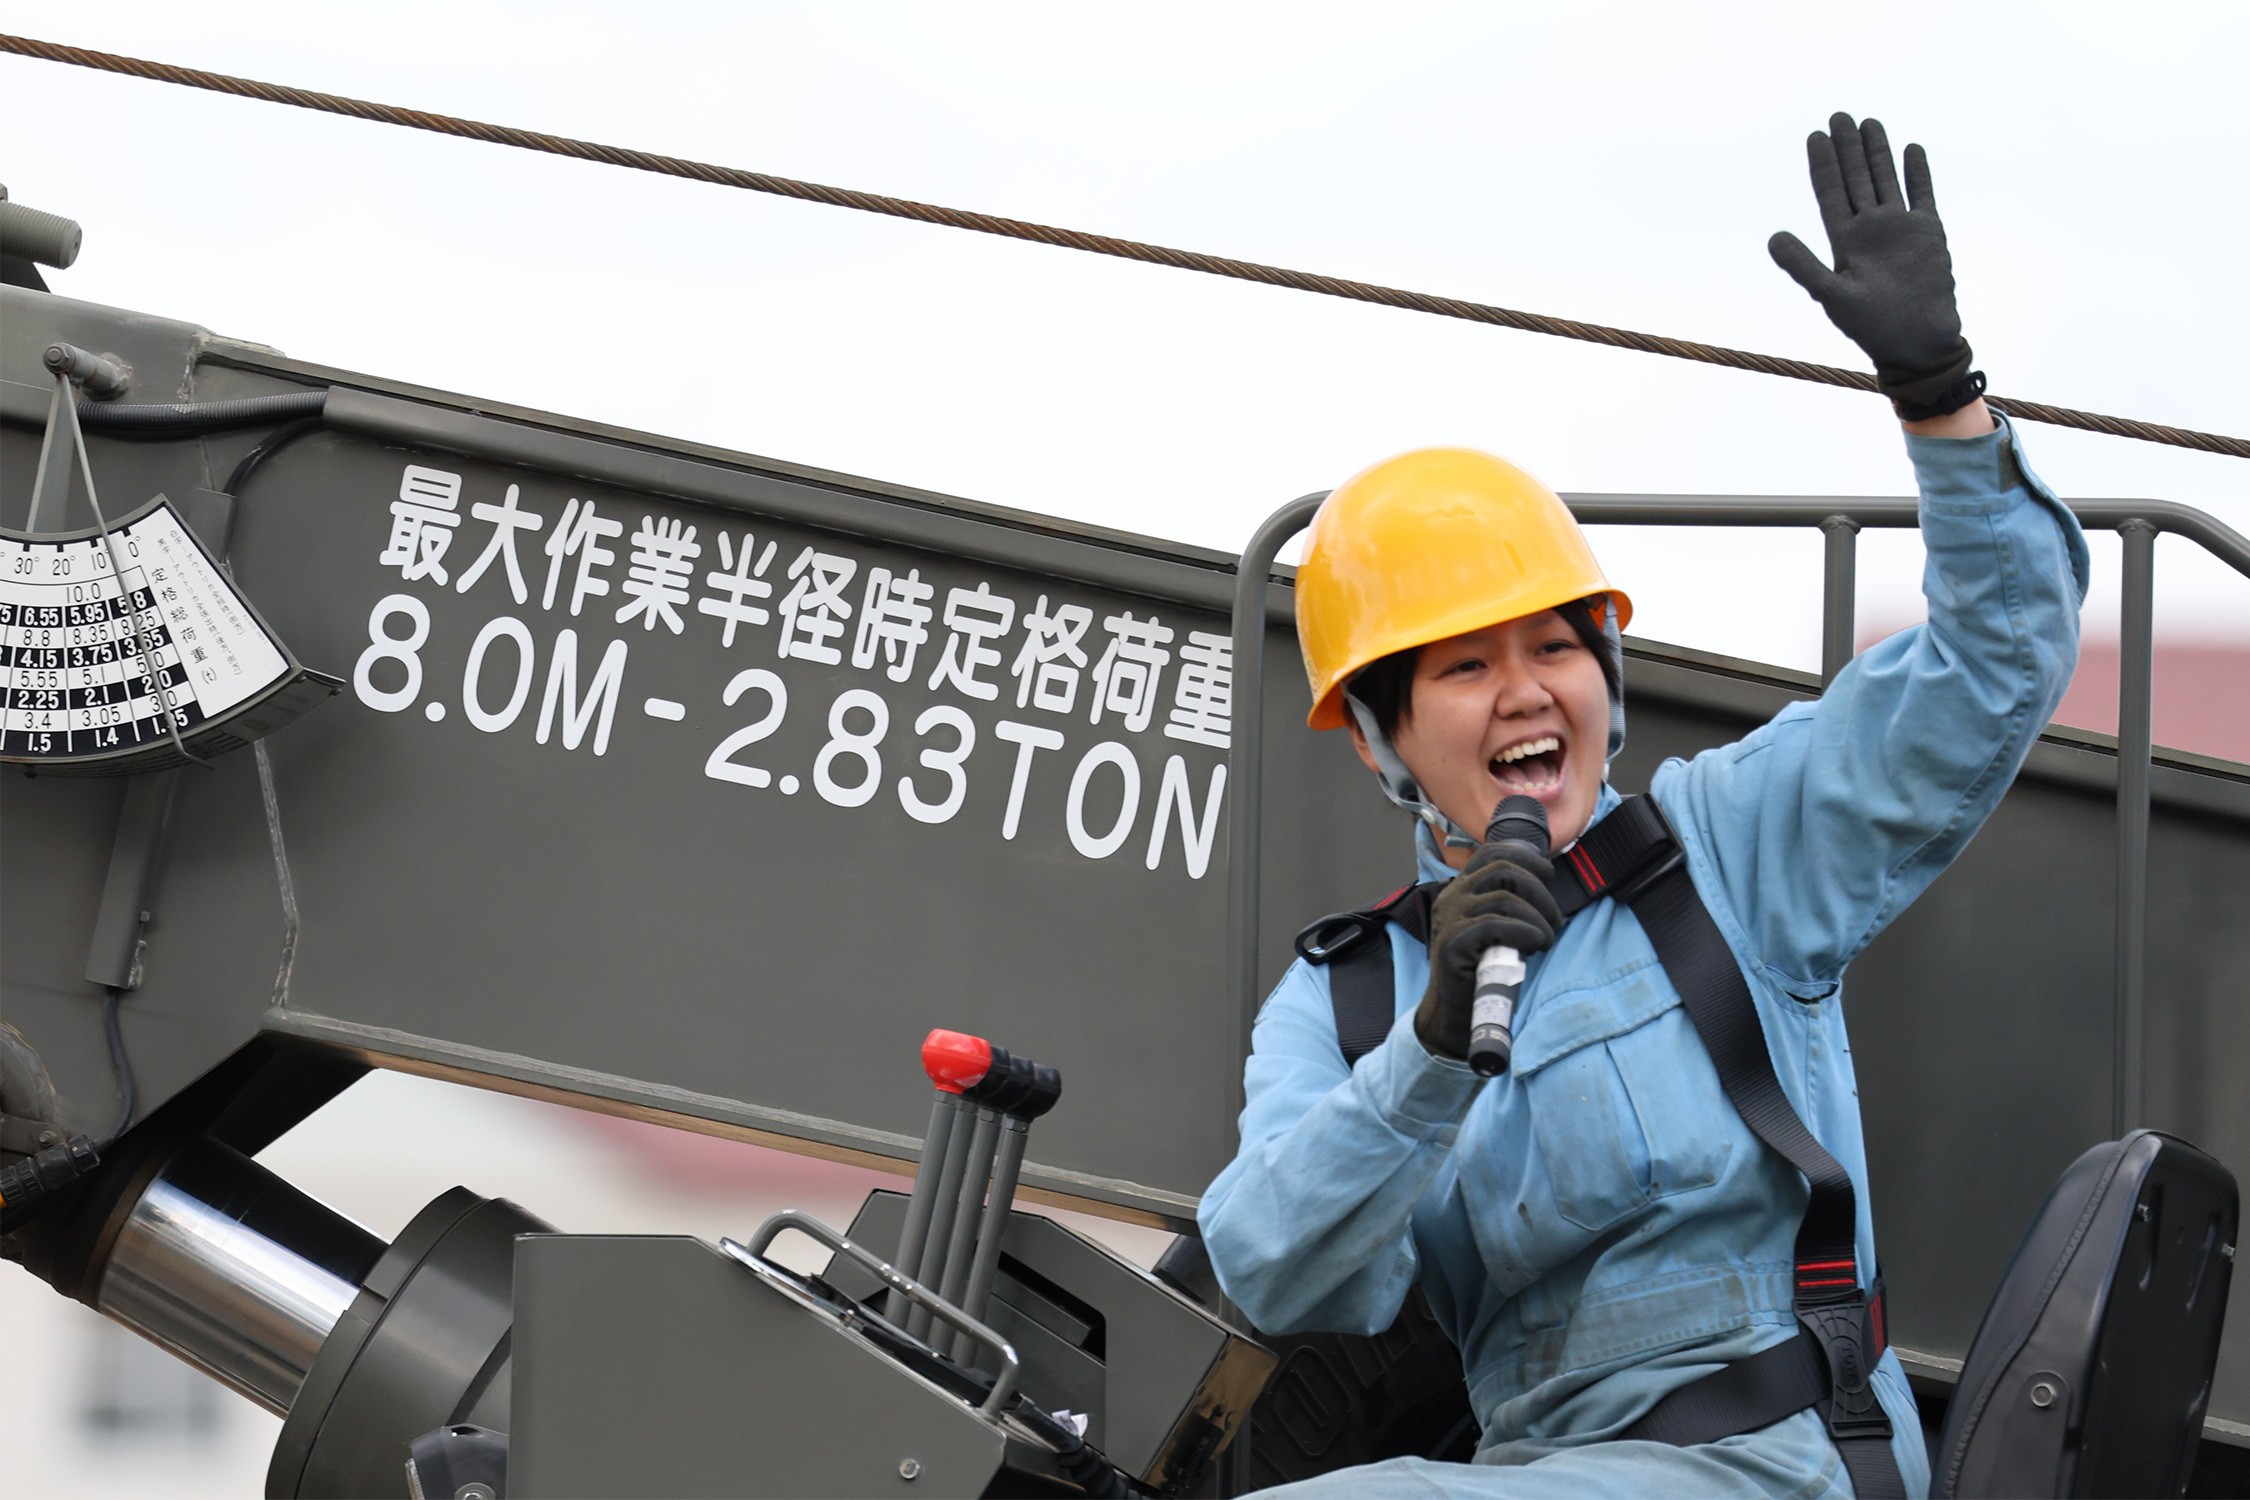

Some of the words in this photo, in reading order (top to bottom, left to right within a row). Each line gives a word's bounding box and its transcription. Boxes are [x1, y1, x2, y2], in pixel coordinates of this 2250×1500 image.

[14, 556, 40, 575] 30°
[52, 555, 76, 576] 20°
[67, 582, 101, 604] 10.0
[379, 464, 1232, 749] 最大作業半径時定格荷重
[24, 607, 59, 626] 6.55
[70, 603, 105, 625] 5.95
[24, 629, 50, 647] 8.8
[73, 624, 108, 644] 8.35
[20, 649, 58, 668] 4.15
[72, 643, 113, 666] 3.75
[20, 670, 58, 688] 5.55
[83, 666, 106, 685] 5.1
[136, 651, 165, 673] 50
[17, 690, 59, 709] 2.25
[84, 686, 110, 706] 2.1
[141, 669, 173, 694] 20
[24, 711, 51, 729] 3.4
[82, 705, 121, 727] 3.05
[150, 690, 177, 712] 30
[28, 733, 51, 752] 1.5
[95, 727, 119, 748] 1.4
[152, 708, 189, 735] 1.5
